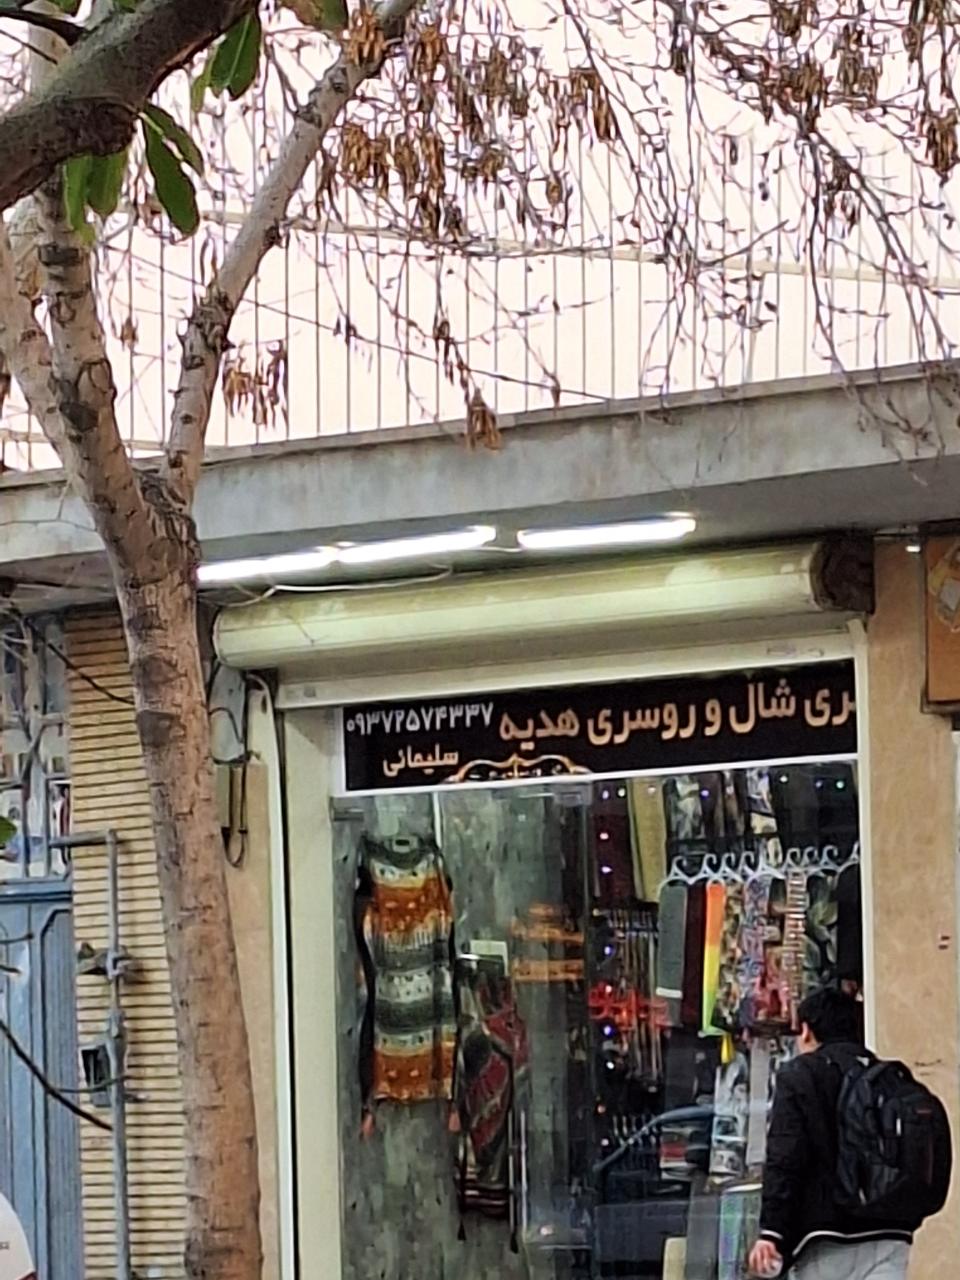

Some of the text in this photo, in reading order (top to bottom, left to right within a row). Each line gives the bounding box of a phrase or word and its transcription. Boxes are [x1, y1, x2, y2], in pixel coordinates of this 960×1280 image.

[499, 678, 857, 750] ری شال و روسری هدیه
[382, 742, 459, 777] سلیمانی
